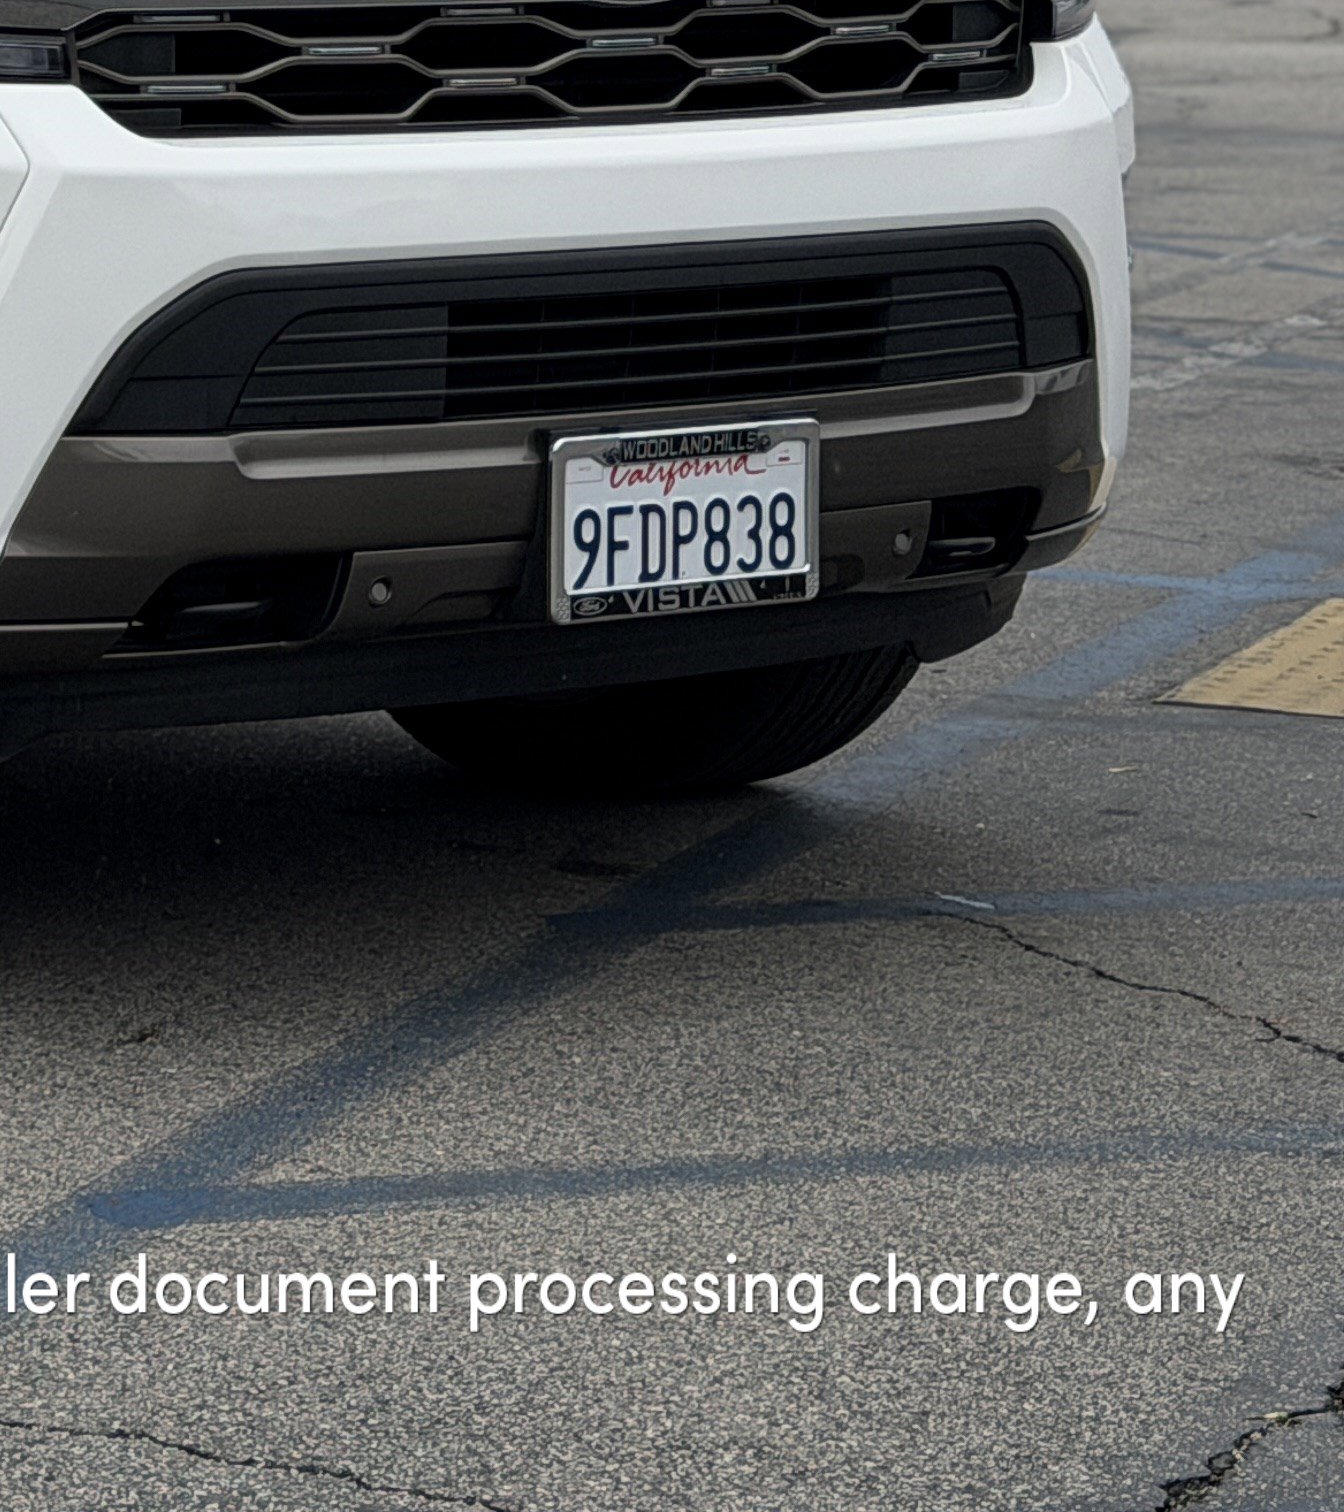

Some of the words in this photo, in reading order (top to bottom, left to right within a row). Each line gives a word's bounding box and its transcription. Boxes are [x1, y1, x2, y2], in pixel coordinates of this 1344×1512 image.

[623, 435, 713, 460] WOODLAND
[714, 430, 756, 453] HILLS
[609, 453, 767, 496] California
[572, 491, 796, 590] 9FDP838
[622, 583, 726, 614] VISTA
